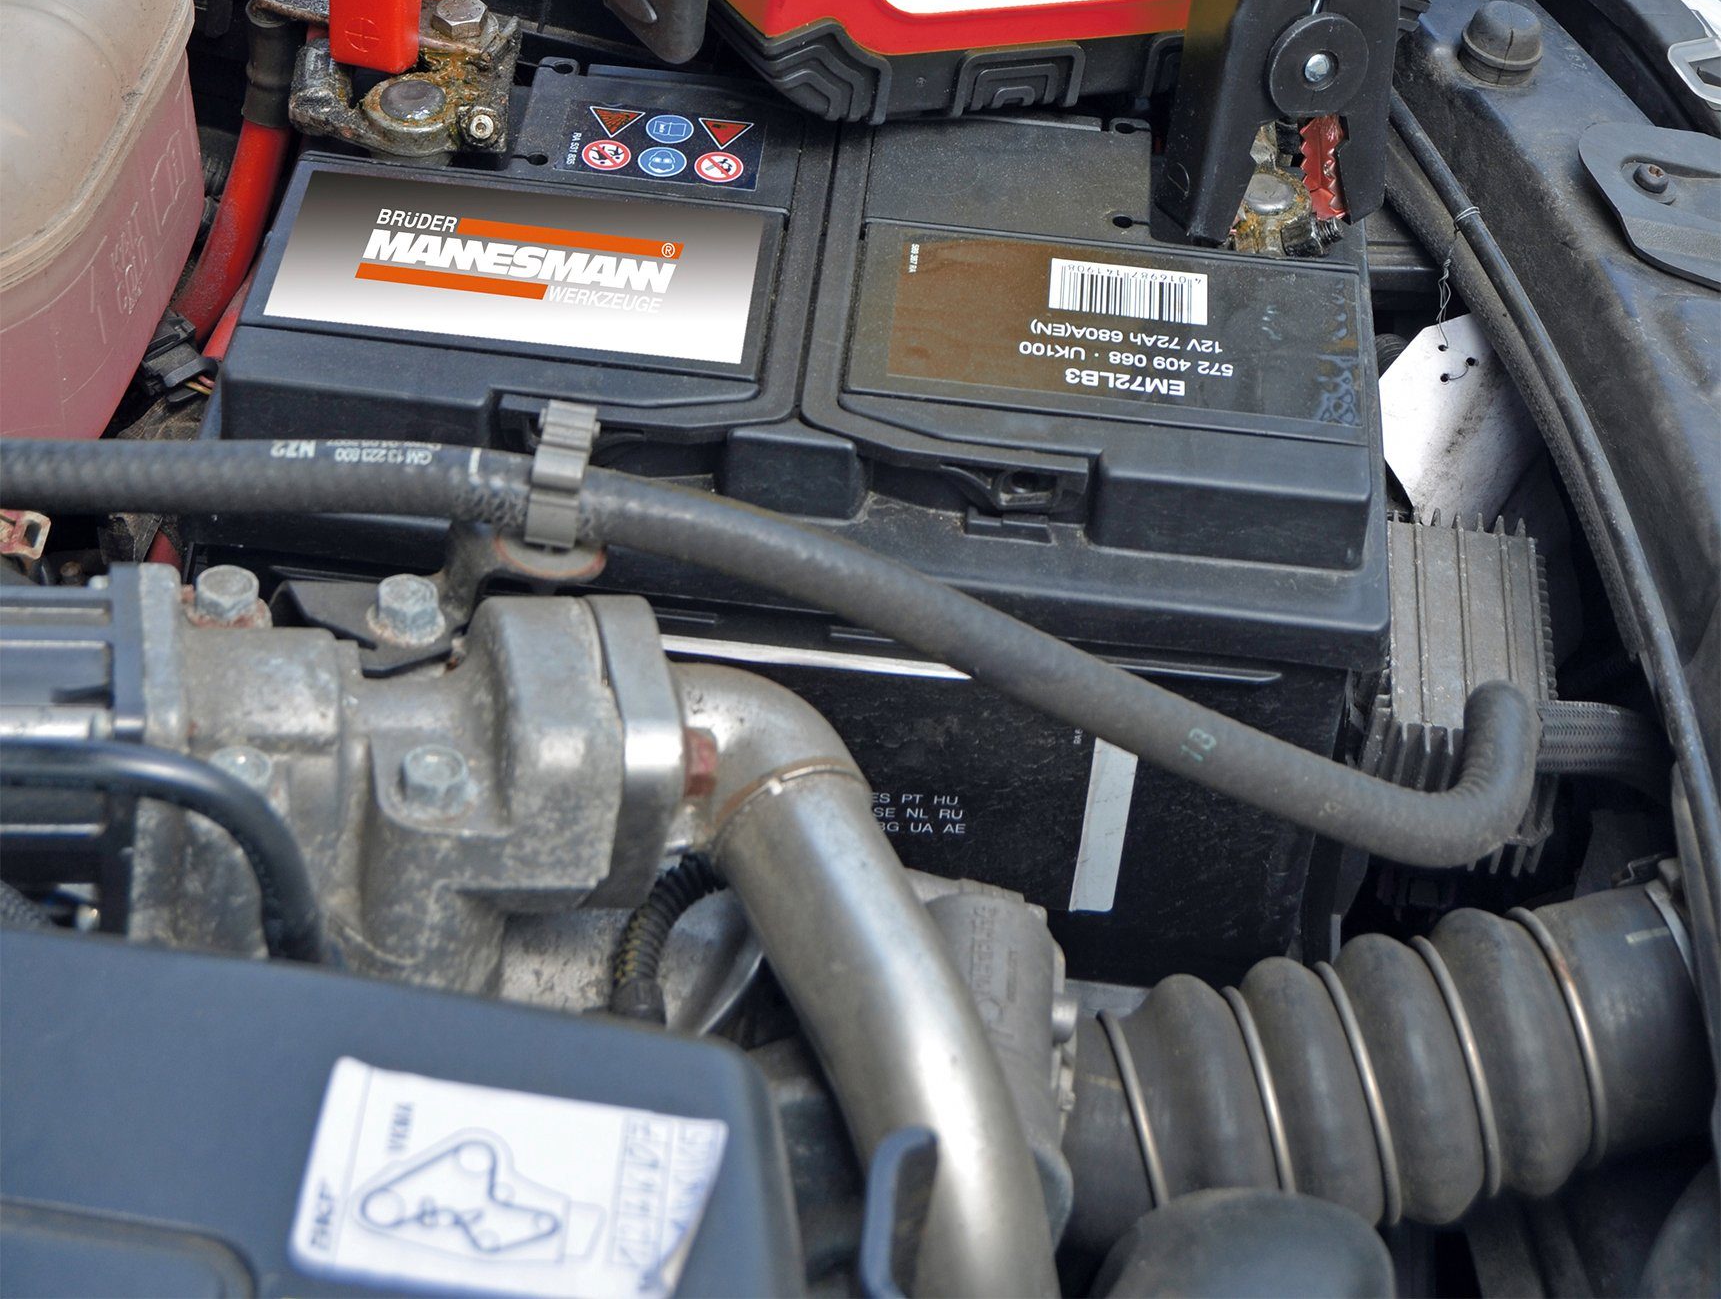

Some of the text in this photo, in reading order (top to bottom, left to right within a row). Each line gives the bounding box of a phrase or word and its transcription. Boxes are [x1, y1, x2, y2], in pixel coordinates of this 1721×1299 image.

[362, 229, 677, 294] MANNESMANN
[548, 285, 663, 315] WERKZEUGE
[1030, 318, 1223, 354] 12V 72Ah 680A(EN)
[1019, 341, 1234, 377] 572 409 068 UK100
[1065, 368, 1185, 396] EM72LB3
[873, 807, 963, 820] SE NL RU
[902, 793, 924, 804] PT
[933, 795, 959, 806] HU
[910, 822, 934, 833] UA
[943, 823, 967, 834] AE
